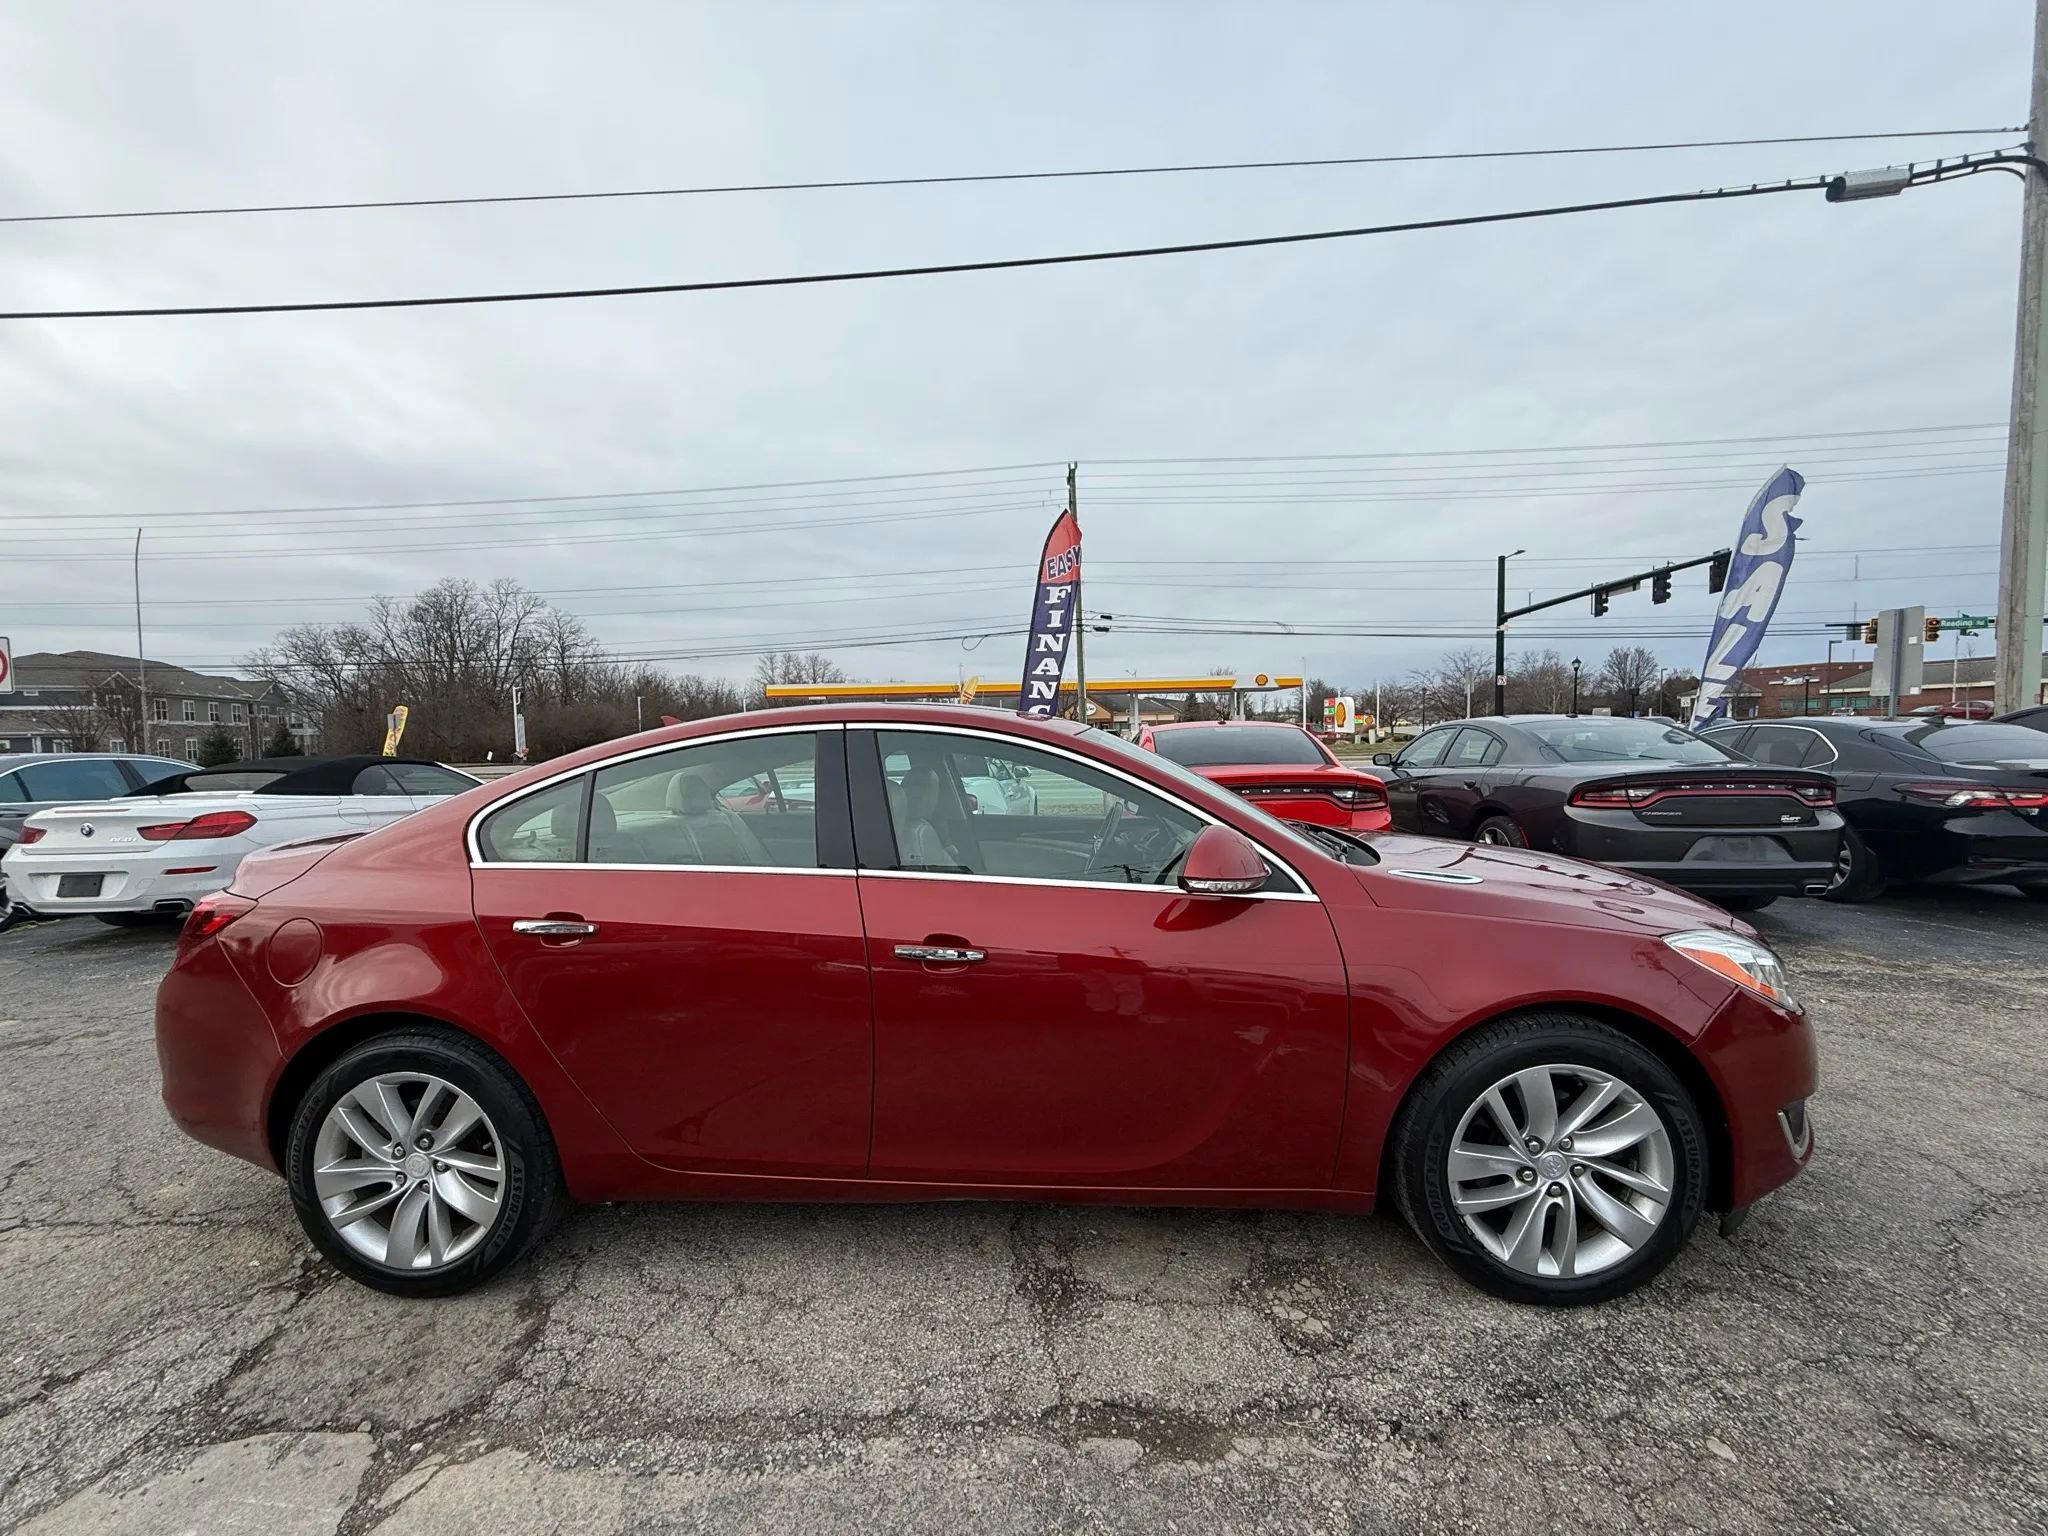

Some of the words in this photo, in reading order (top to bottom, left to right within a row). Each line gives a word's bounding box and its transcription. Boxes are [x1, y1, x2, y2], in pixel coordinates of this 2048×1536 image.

[1046, 546, 1082, 580] EASY
[1940, 619, 1973, 630] Reading
[291, 1094, 322, 1185] GOODYEAR
[1425, 1132, 1452, 1234] GOODYEAR
[1676, 1117, 1701, 1212] ASSURANCE
[493, 1165, 523, 1252] ASSURANCE
